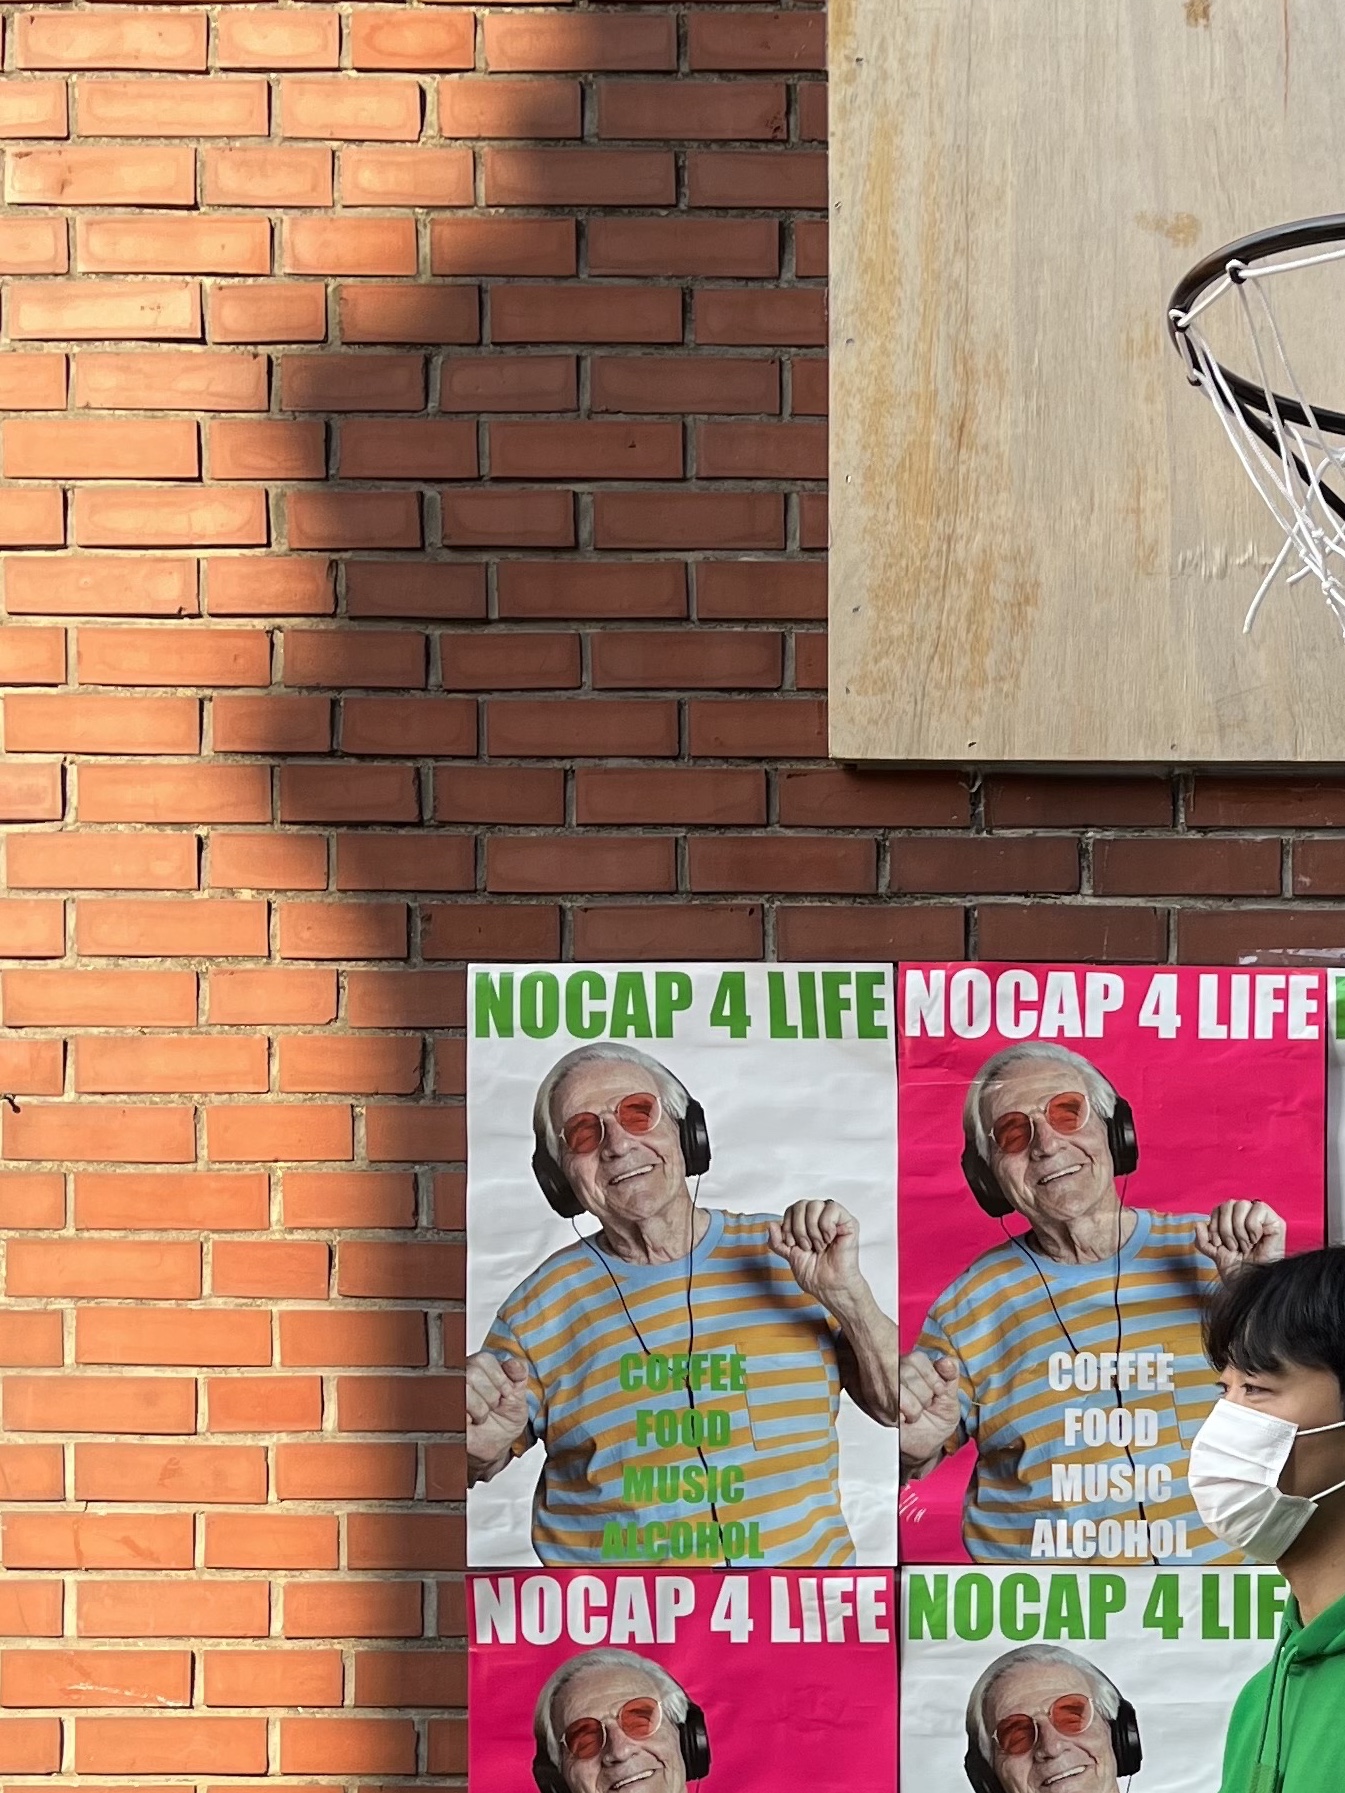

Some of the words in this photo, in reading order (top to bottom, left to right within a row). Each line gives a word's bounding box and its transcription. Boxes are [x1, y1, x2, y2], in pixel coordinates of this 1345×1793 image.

[474, 971, 692, 1038] NOCAP
[711, 971, 751, 1038] 4
[769, 971, 888, 1038] LIFE
[905, 970, 1124, 1039] NOCAP
[1139, 972, 1181, 1038] 4
[1198, 973, 1320, 1039] LIFE
[619, 1353, 746, 1391] COFFEE
[1049, 1353, 1175, 1391] COFFEE
[636, 1410, 730, 1448] FOOD
[1064, 1410, 1158, 1448] FOOD
[622, 1466, 744, 1505] MUSIC
[1051, 1466, 1171, 1504] MUSIC
[602, 1522, 764, 1560] ALCOHOL
[1031, 1521, 1192, 1559] ALCOHOL
[476, 1575, 694, 1645] NOCAP
[711, 1577, 752, 1644] 4
[770, 1577, 889, 1644] LIFE
[908, 1573, 1126, 1641] NOCAP
[1143, 1573, 1182, 1640] 4
[1202, 1574, 1286, 1639] LIF
